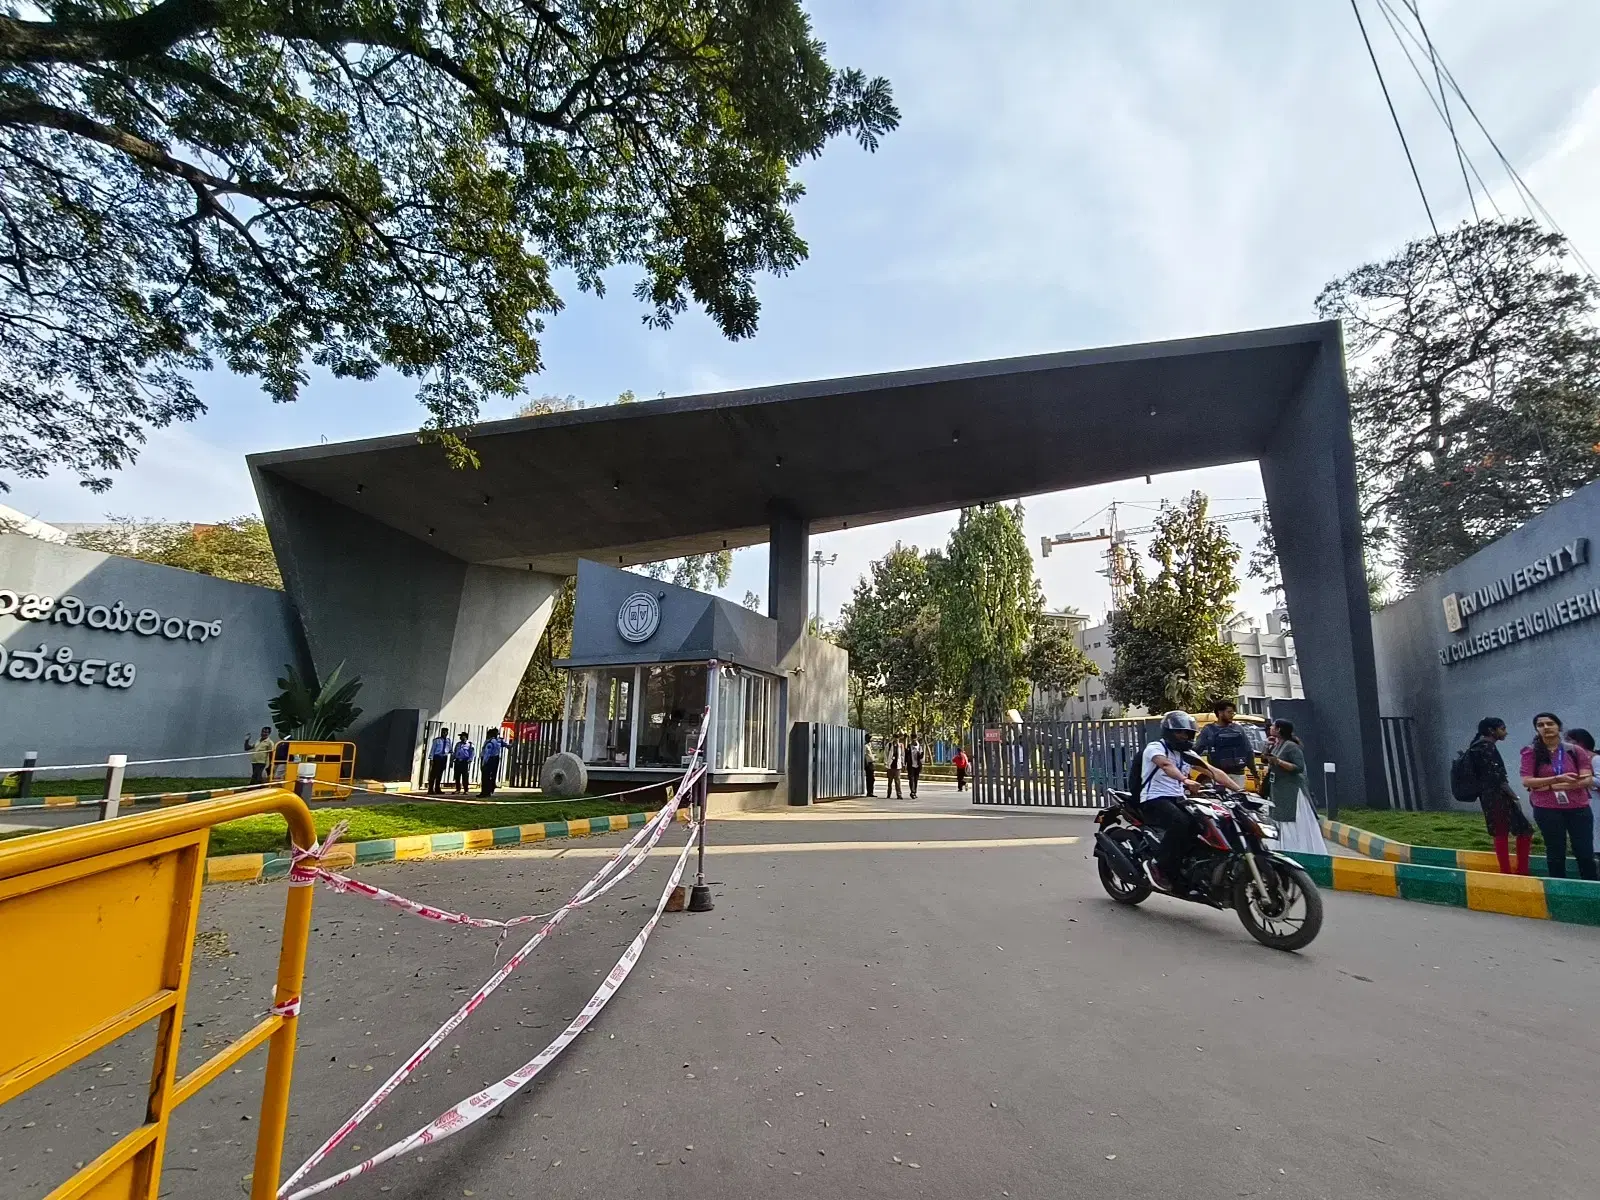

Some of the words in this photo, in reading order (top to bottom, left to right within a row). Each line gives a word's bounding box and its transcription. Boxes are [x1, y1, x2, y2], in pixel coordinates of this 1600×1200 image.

[1460, 592, 1477, 616] RV
[1478, 538, 1585, 607] UNIVERSITY
[0, 589, 223, 643] ಂಜಿನಿಯರಿಂಗ್
[0, 643, 136, 689] ವರ್ಸಿಟಿ
[1438, 646, 1451, 665] RV
[1451, 631, 1498, 661] COLLEGE
[1498, 622, 1513, 645] OF
